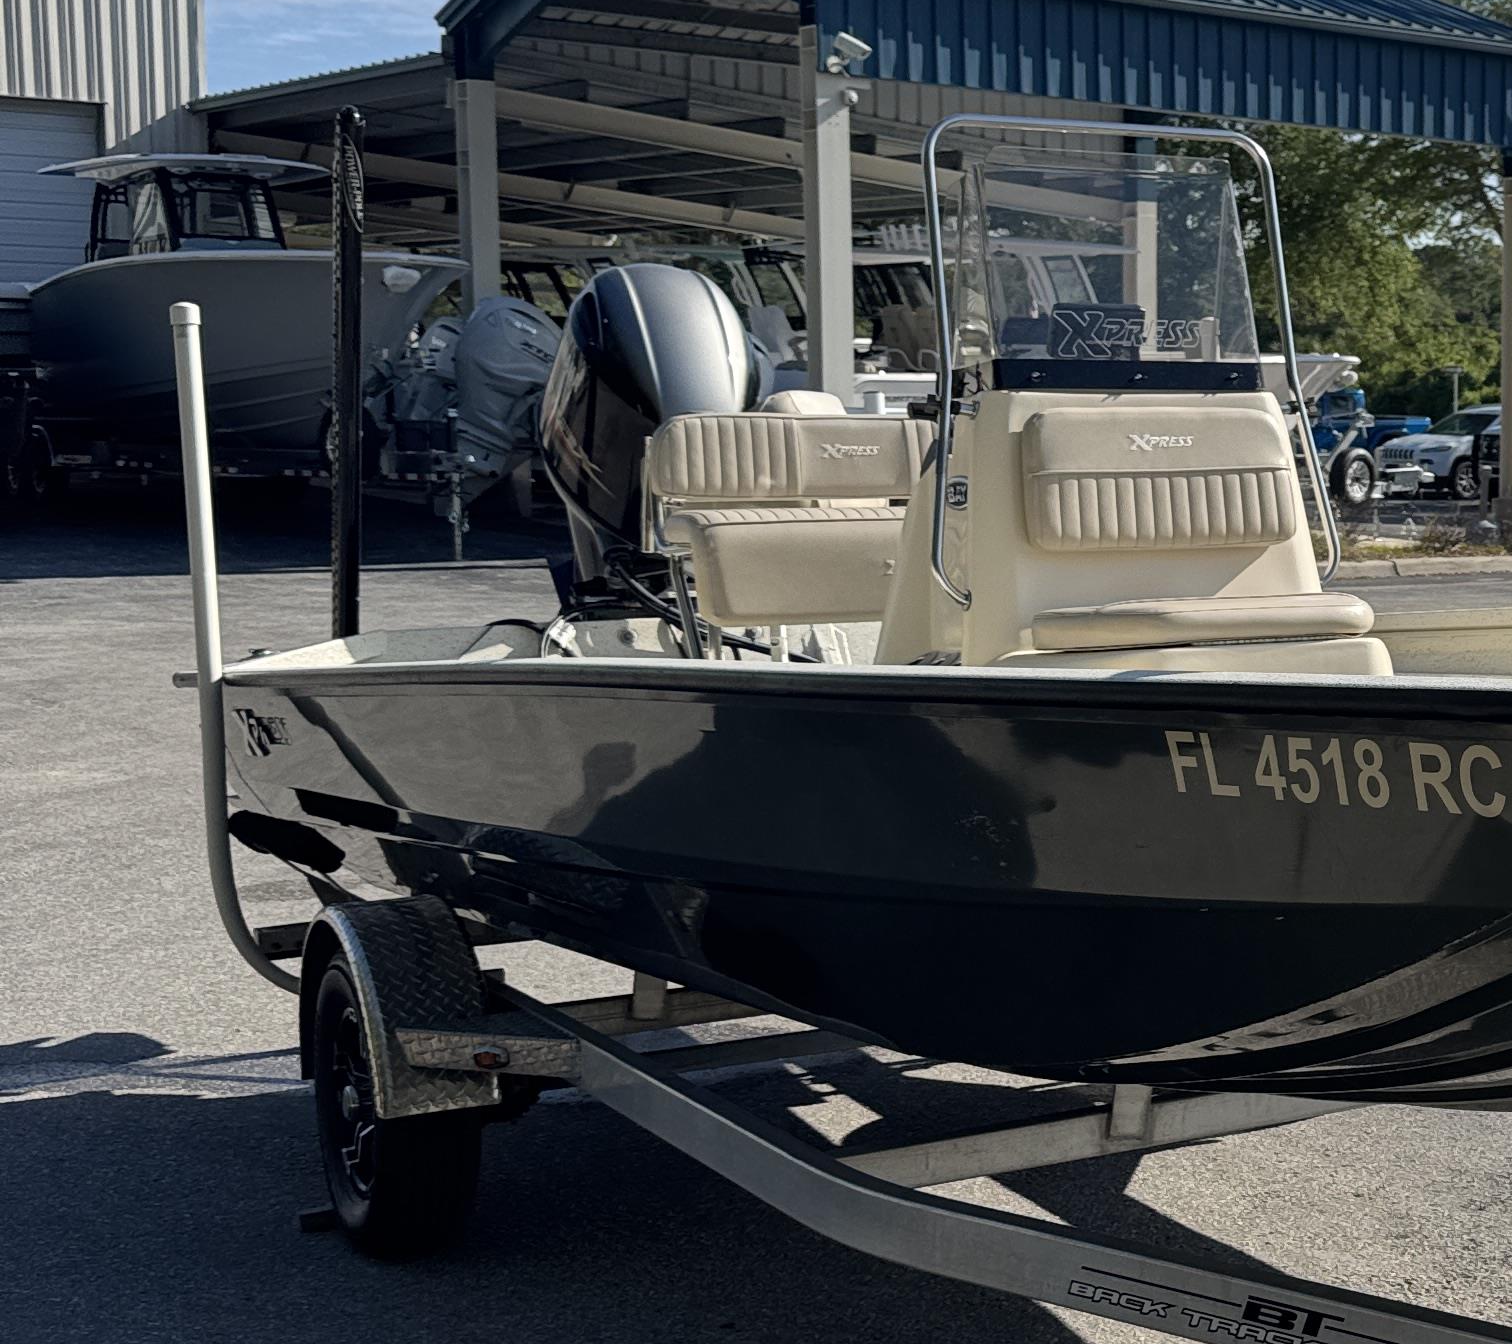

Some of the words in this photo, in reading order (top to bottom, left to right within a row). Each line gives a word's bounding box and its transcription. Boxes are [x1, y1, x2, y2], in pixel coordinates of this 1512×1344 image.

[1052, 310, 1202, 357] XPRESS
[819, 442, 881, 460] XPRESS
[1128, 432, 1194, 452] XPRESS
[1164, 730, 1241, 797] FL
[1254, 734, 1390, 808] 4518
[1408, 741, 1507, 818] RC
[1067, 1279, 1178, 1318] BACK
[1241, 1295, 1345, 1337] BT
